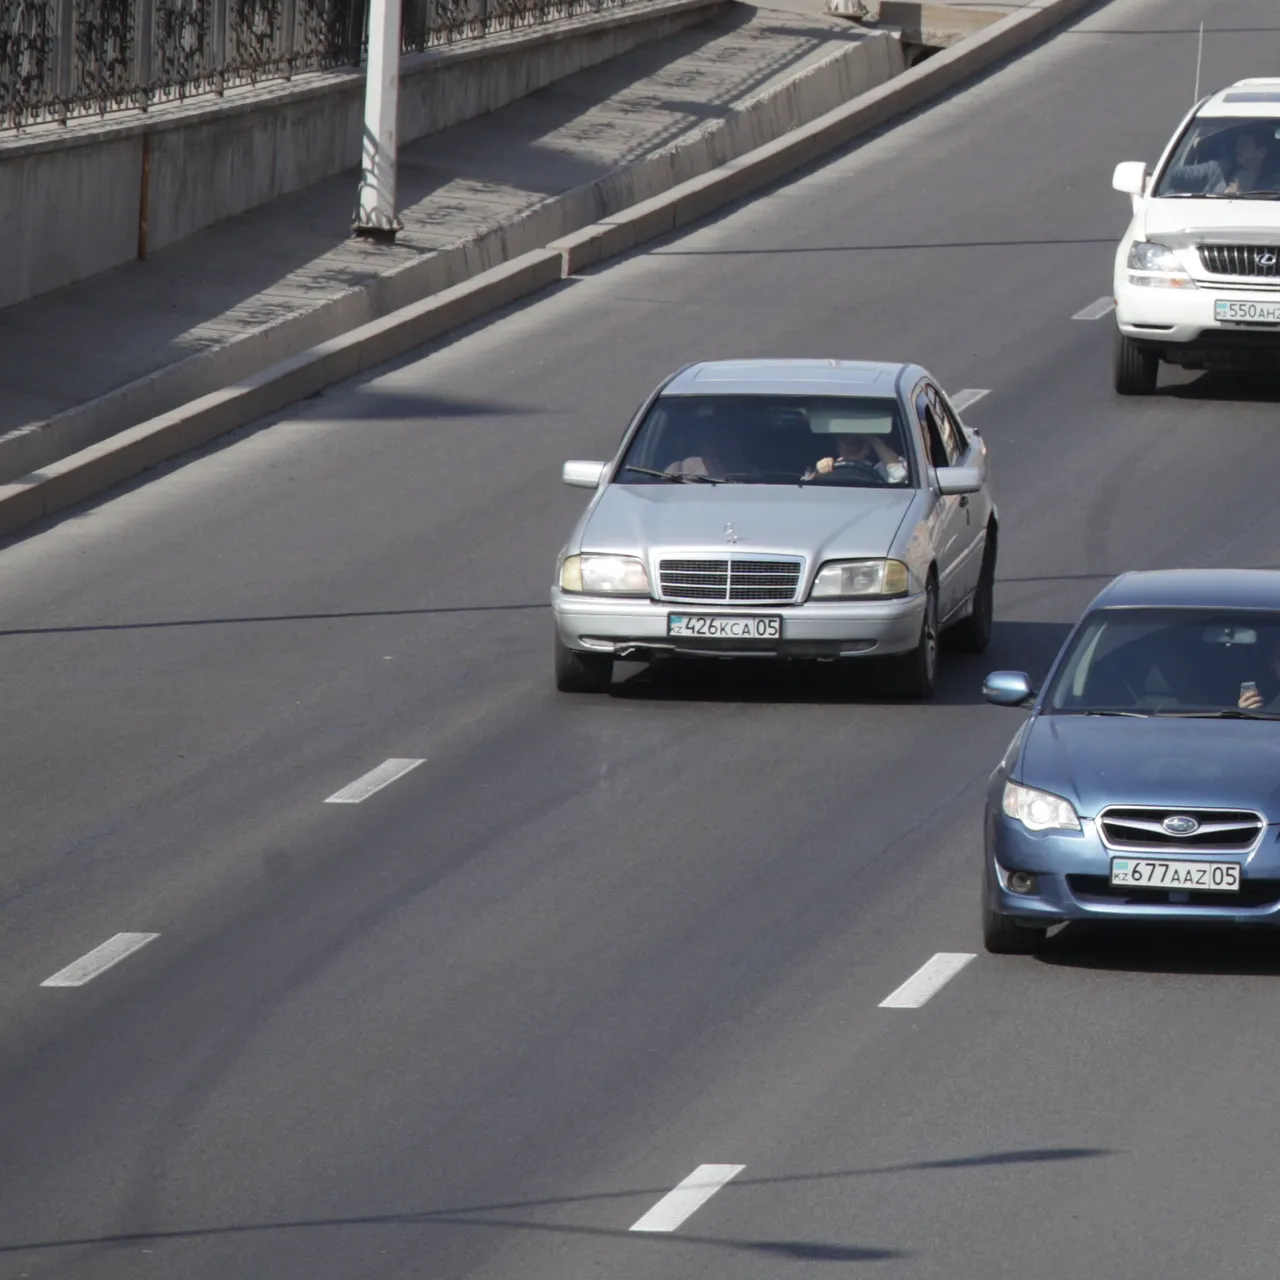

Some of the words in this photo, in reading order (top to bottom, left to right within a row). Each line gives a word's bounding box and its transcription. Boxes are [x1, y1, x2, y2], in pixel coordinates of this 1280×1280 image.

[756, 620, 778, 636] 05
[1131, 862, 1207, 885] 677AAZ
[1212, 866, 1237, 886] 05
